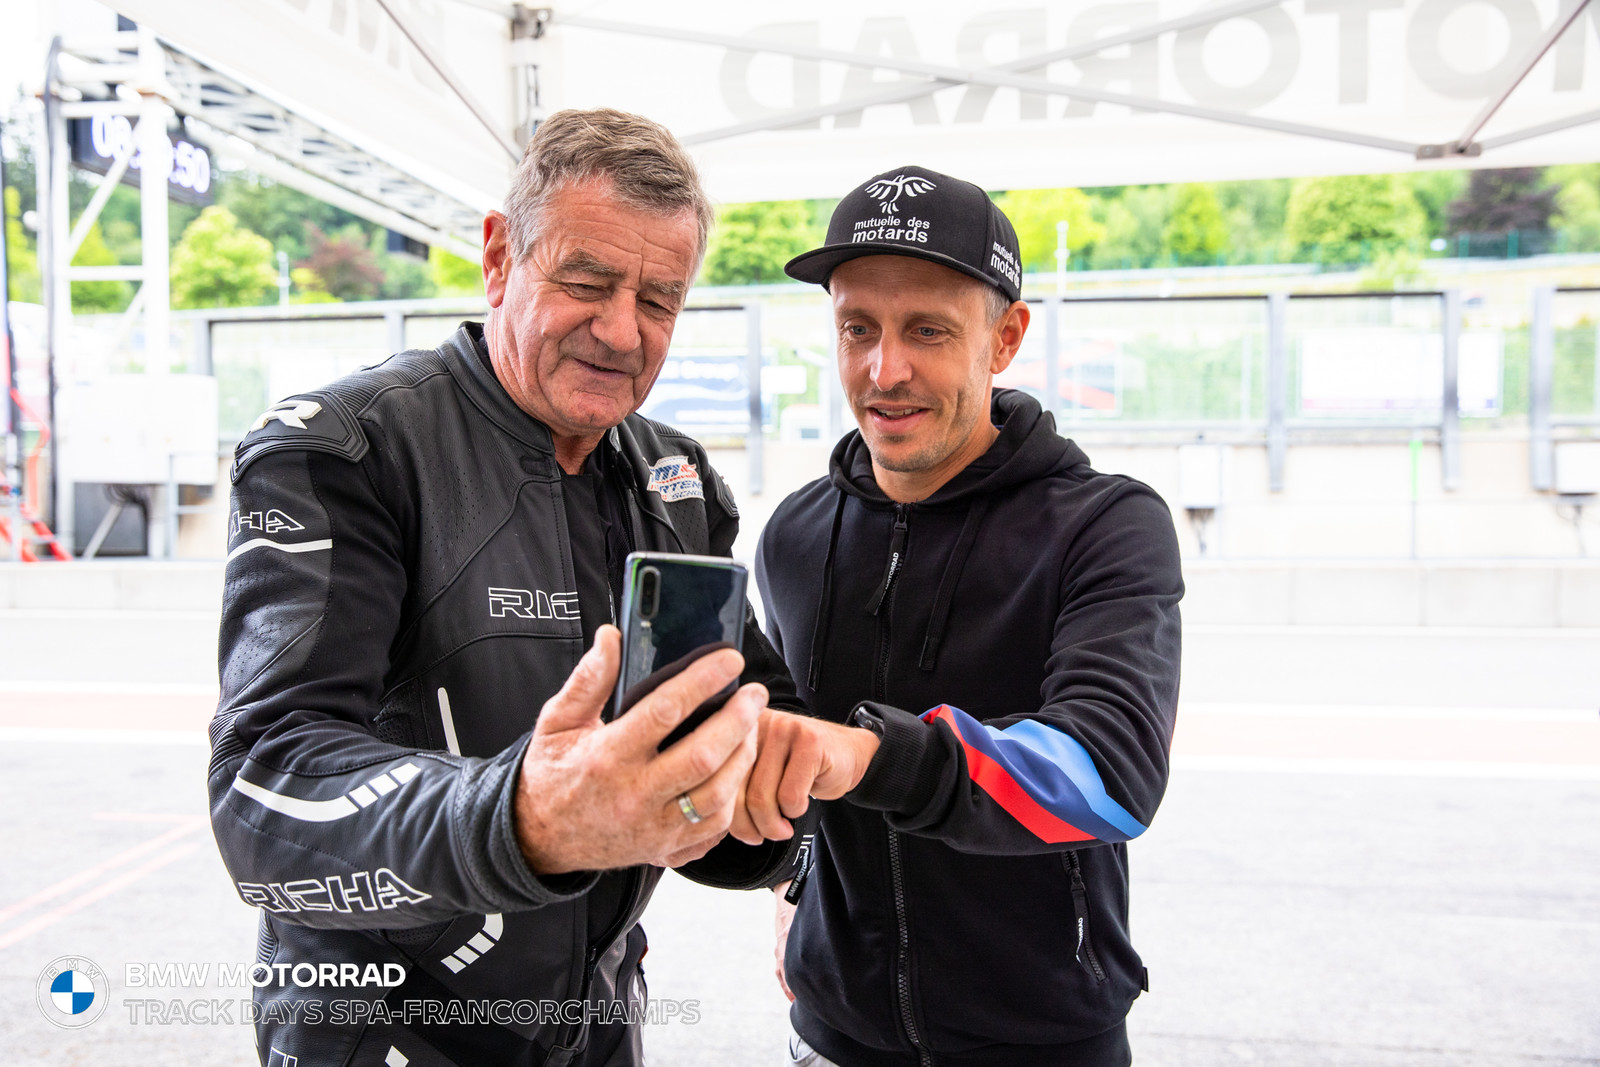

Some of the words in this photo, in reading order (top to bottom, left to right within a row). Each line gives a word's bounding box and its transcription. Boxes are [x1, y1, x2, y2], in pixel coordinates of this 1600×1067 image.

[854, 216, 900, 231] mutuelle
[907, 216, 931, 229] des
[852, 226, 928, 244] motards
[238, 868, 433, 914] RICHA
